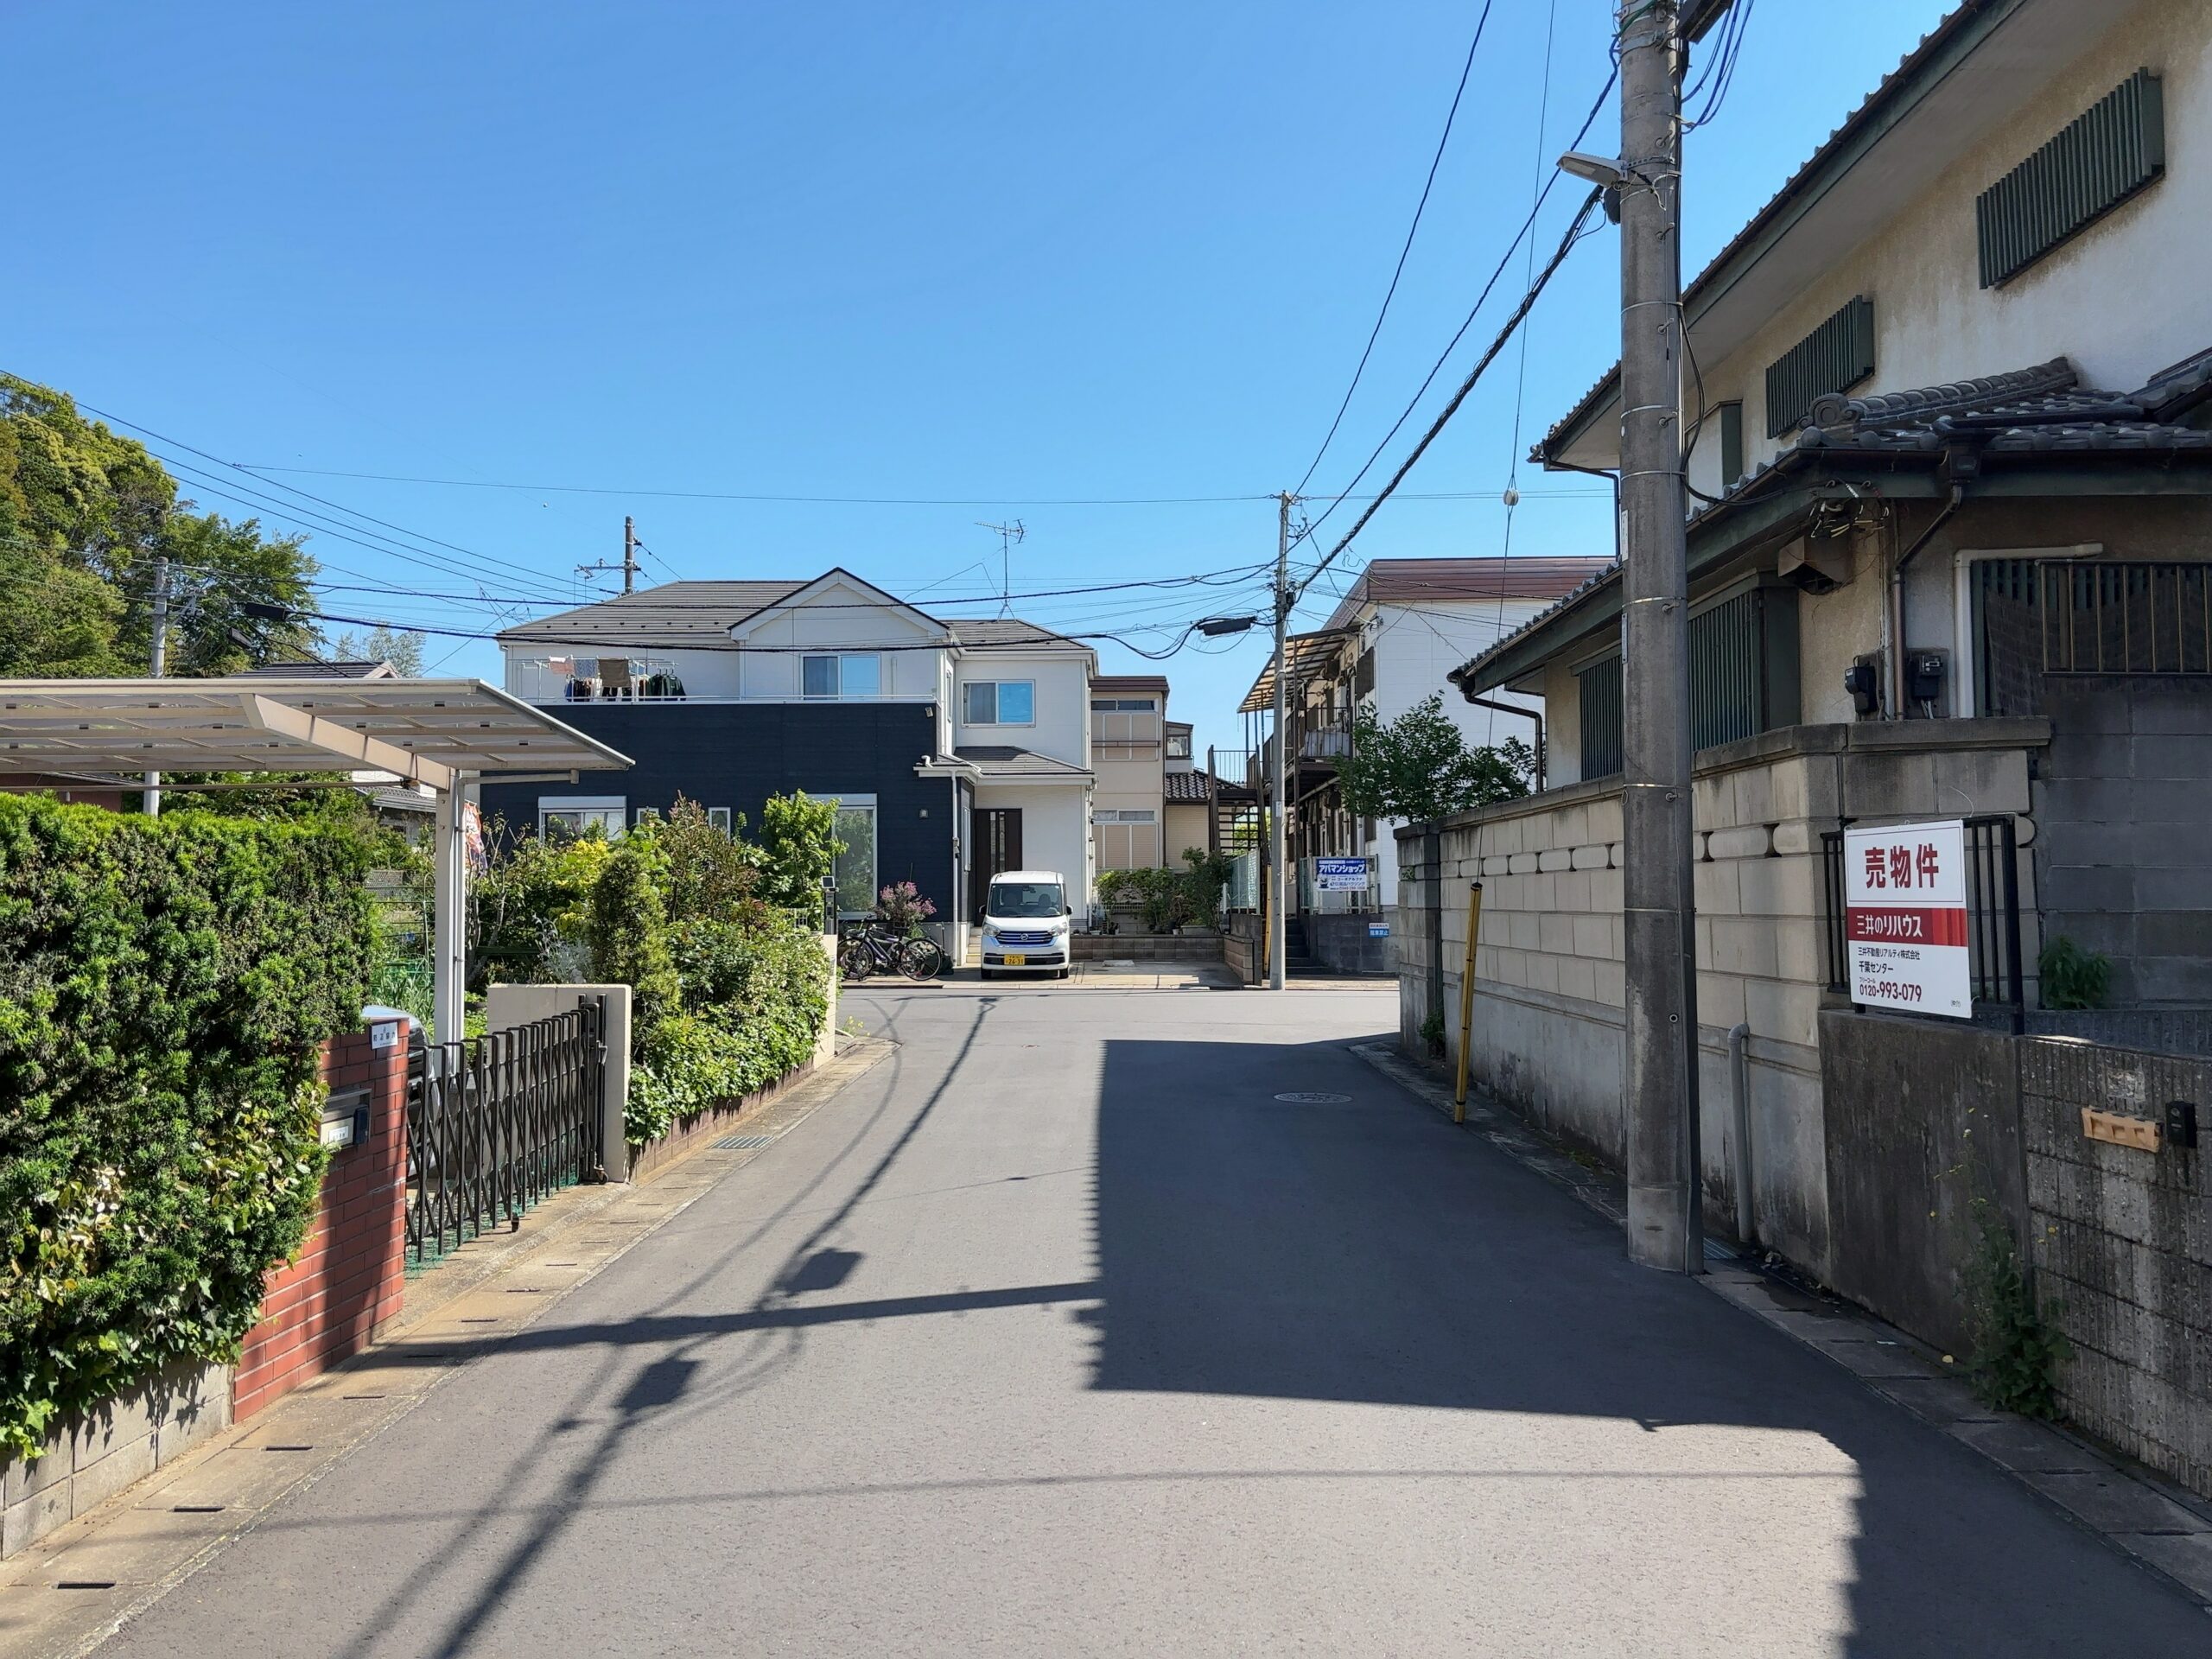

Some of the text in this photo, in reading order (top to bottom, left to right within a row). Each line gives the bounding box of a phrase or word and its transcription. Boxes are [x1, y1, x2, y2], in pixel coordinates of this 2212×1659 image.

[1319, 864, 1365, 873] アパマンショップ
[1865, 843, 1939, 889] 売物件
[1856, 913, 1923, 938] 三井のリハウス
[1858, 946, 1921, 960] 三井不動産リアルティ株式会社
[1859, 961, 1894, 974] 千葉センター
[1859, 981, 1923, 1002] 0120-993-079
